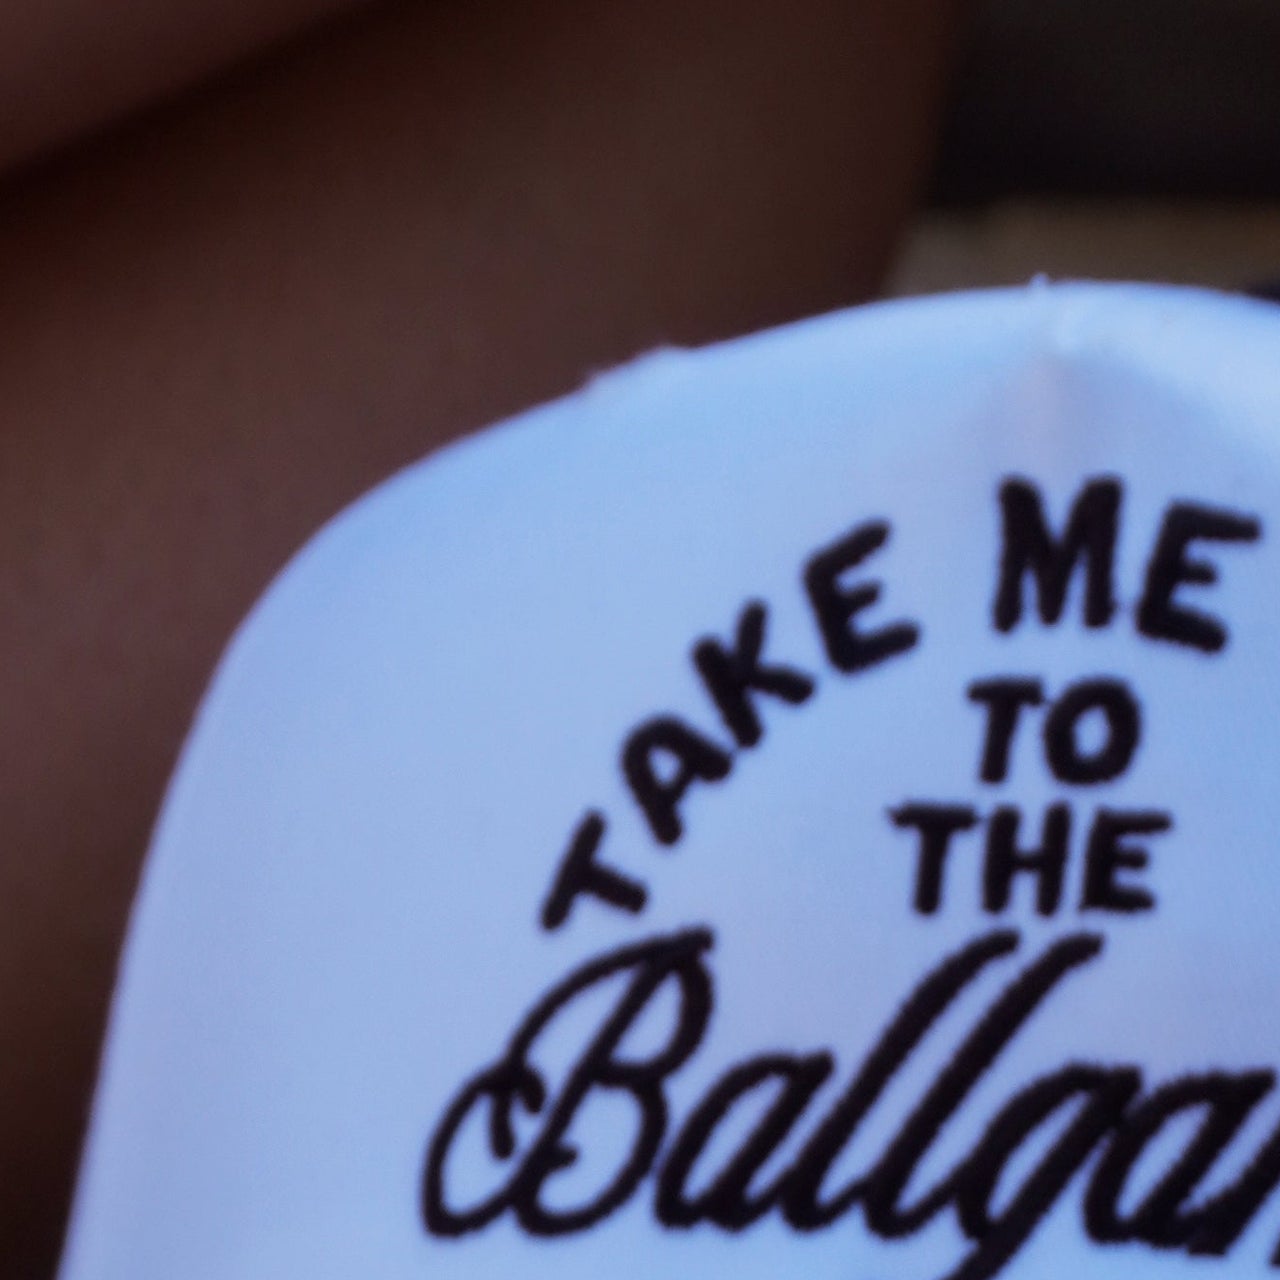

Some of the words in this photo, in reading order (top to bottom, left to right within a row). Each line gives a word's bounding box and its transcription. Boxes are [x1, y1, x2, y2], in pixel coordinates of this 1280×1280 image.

[540, 523, 920, 932] TAKE
[992, 476, 1261, 655] ME
[966, 677, 1142, 787] TO
[887, 801, 1173, 918] THE
